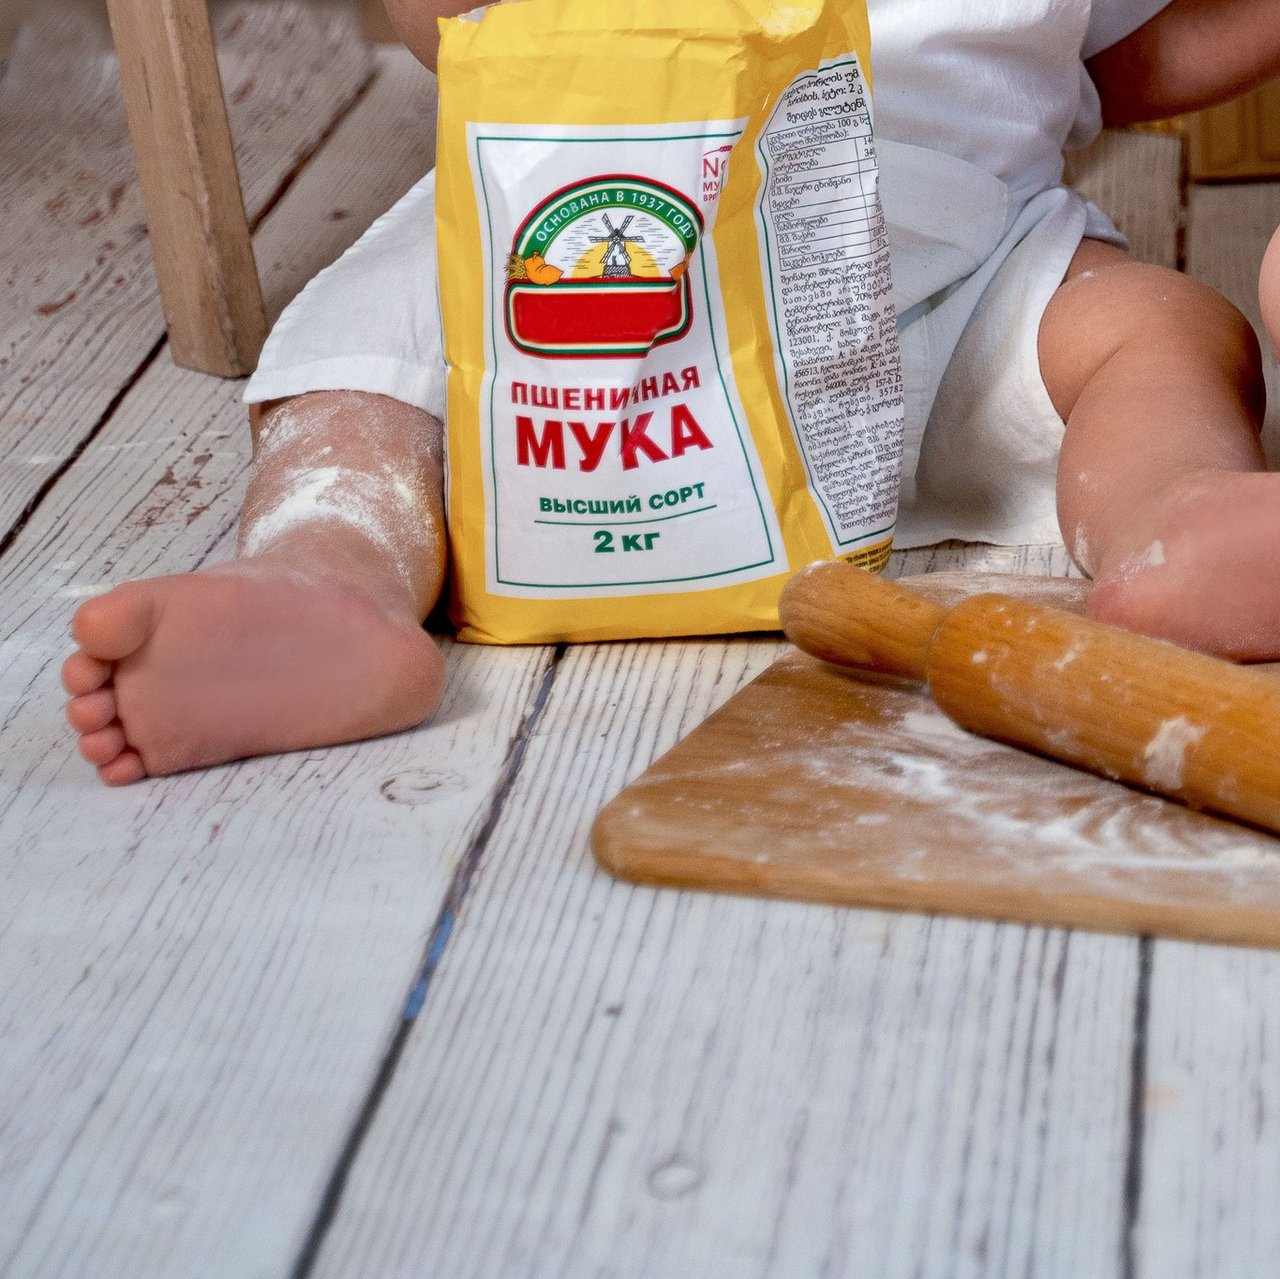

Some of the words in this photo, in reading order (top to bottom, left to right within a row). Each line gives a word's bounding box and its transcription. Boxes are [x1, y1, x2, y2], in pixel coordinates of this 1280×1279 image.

[848, 83, 855, 93] 2
[837, 118, 851, 128] 100
[535, 192, 610, 242] ОСНОВАНА
[616, 190, 625, 202] В
[631, 192, 665, 211] 1937
[666, 208, 696, 240] ГОДУ
[789, 334, 820, 347] 123001,
[515, 403, 714, 473] МУКА
[539, 495, 642, 514] ВЫСШИЙ
[648, 482, 705, 509] СОРТ
[593, 530, 615, 553] 2
